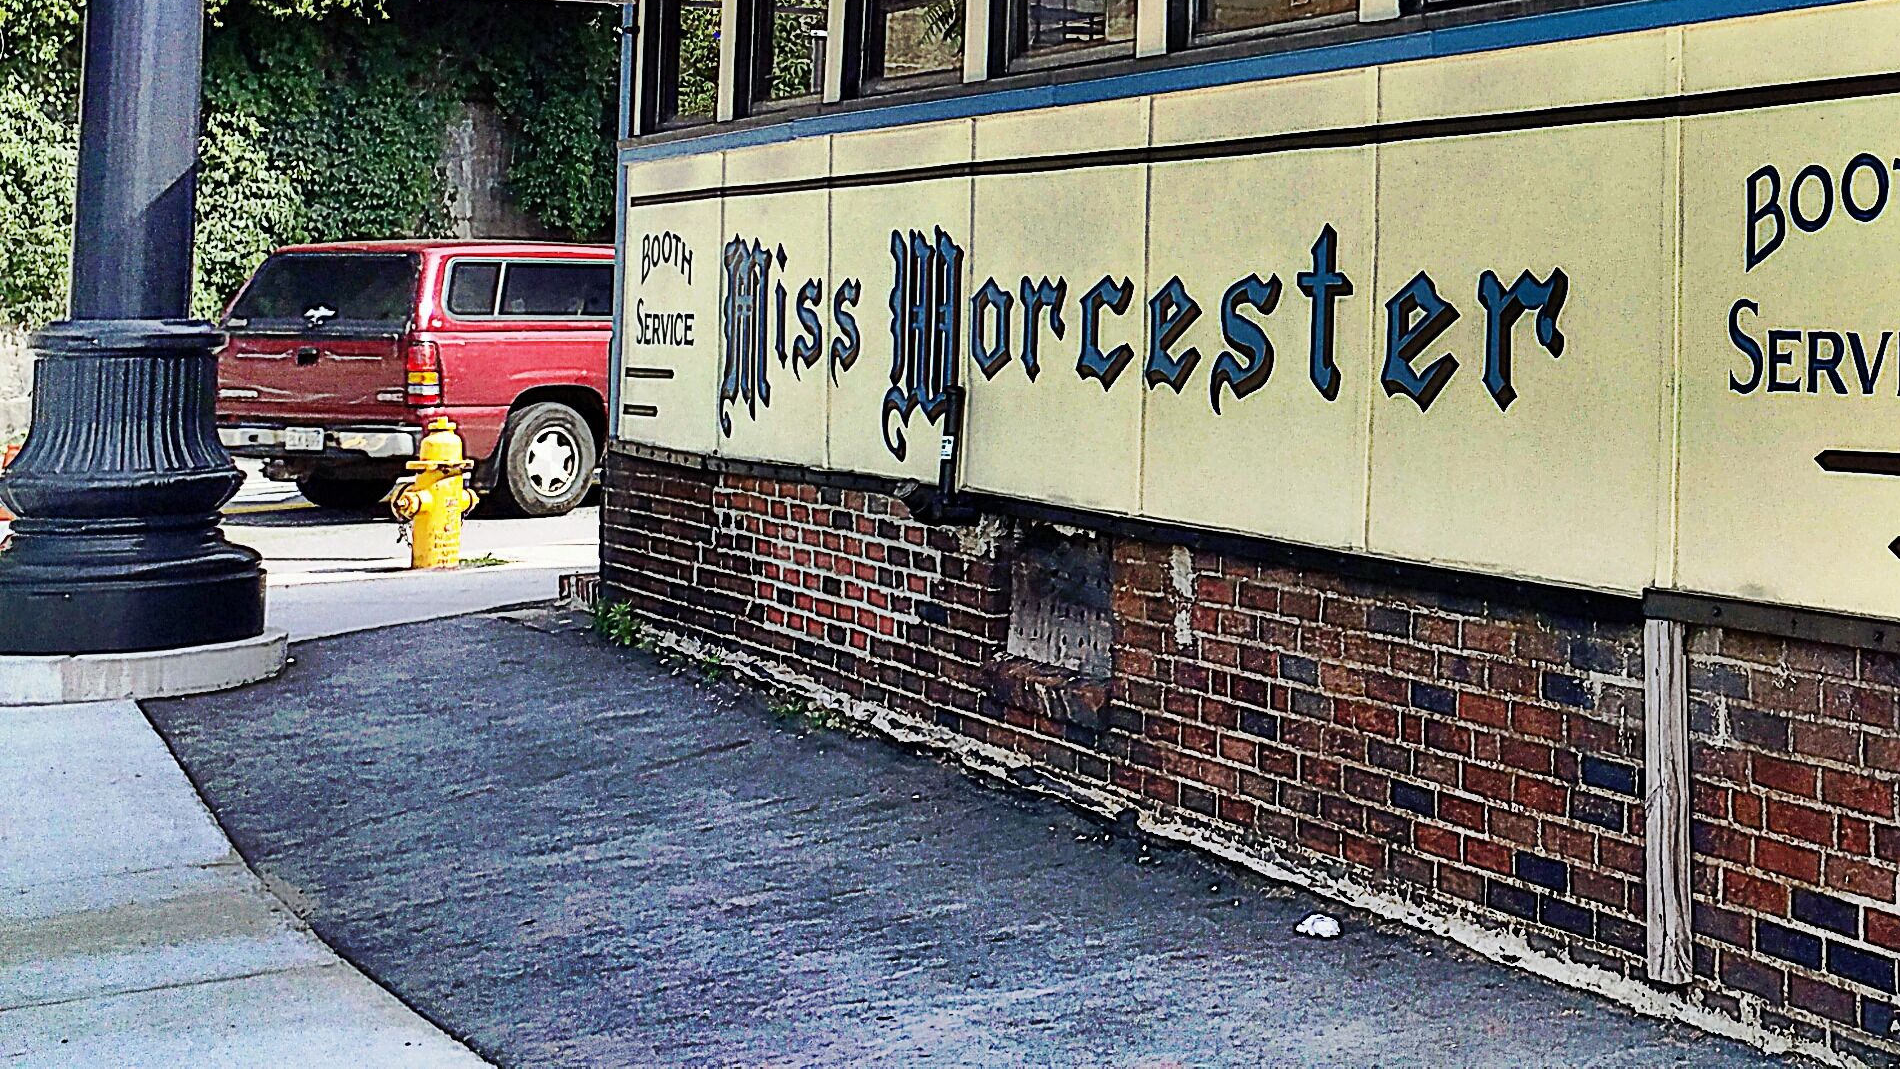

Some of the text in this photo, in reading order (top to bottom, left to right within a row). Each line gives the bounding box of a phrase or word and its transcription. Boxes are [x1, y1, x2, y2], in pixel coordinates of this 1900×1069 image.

[640, 230, 693, 285] BOOTH
[635, 297, 695, 347] SERVICE
[719, 222, 1570, 463] Miss Worcester
